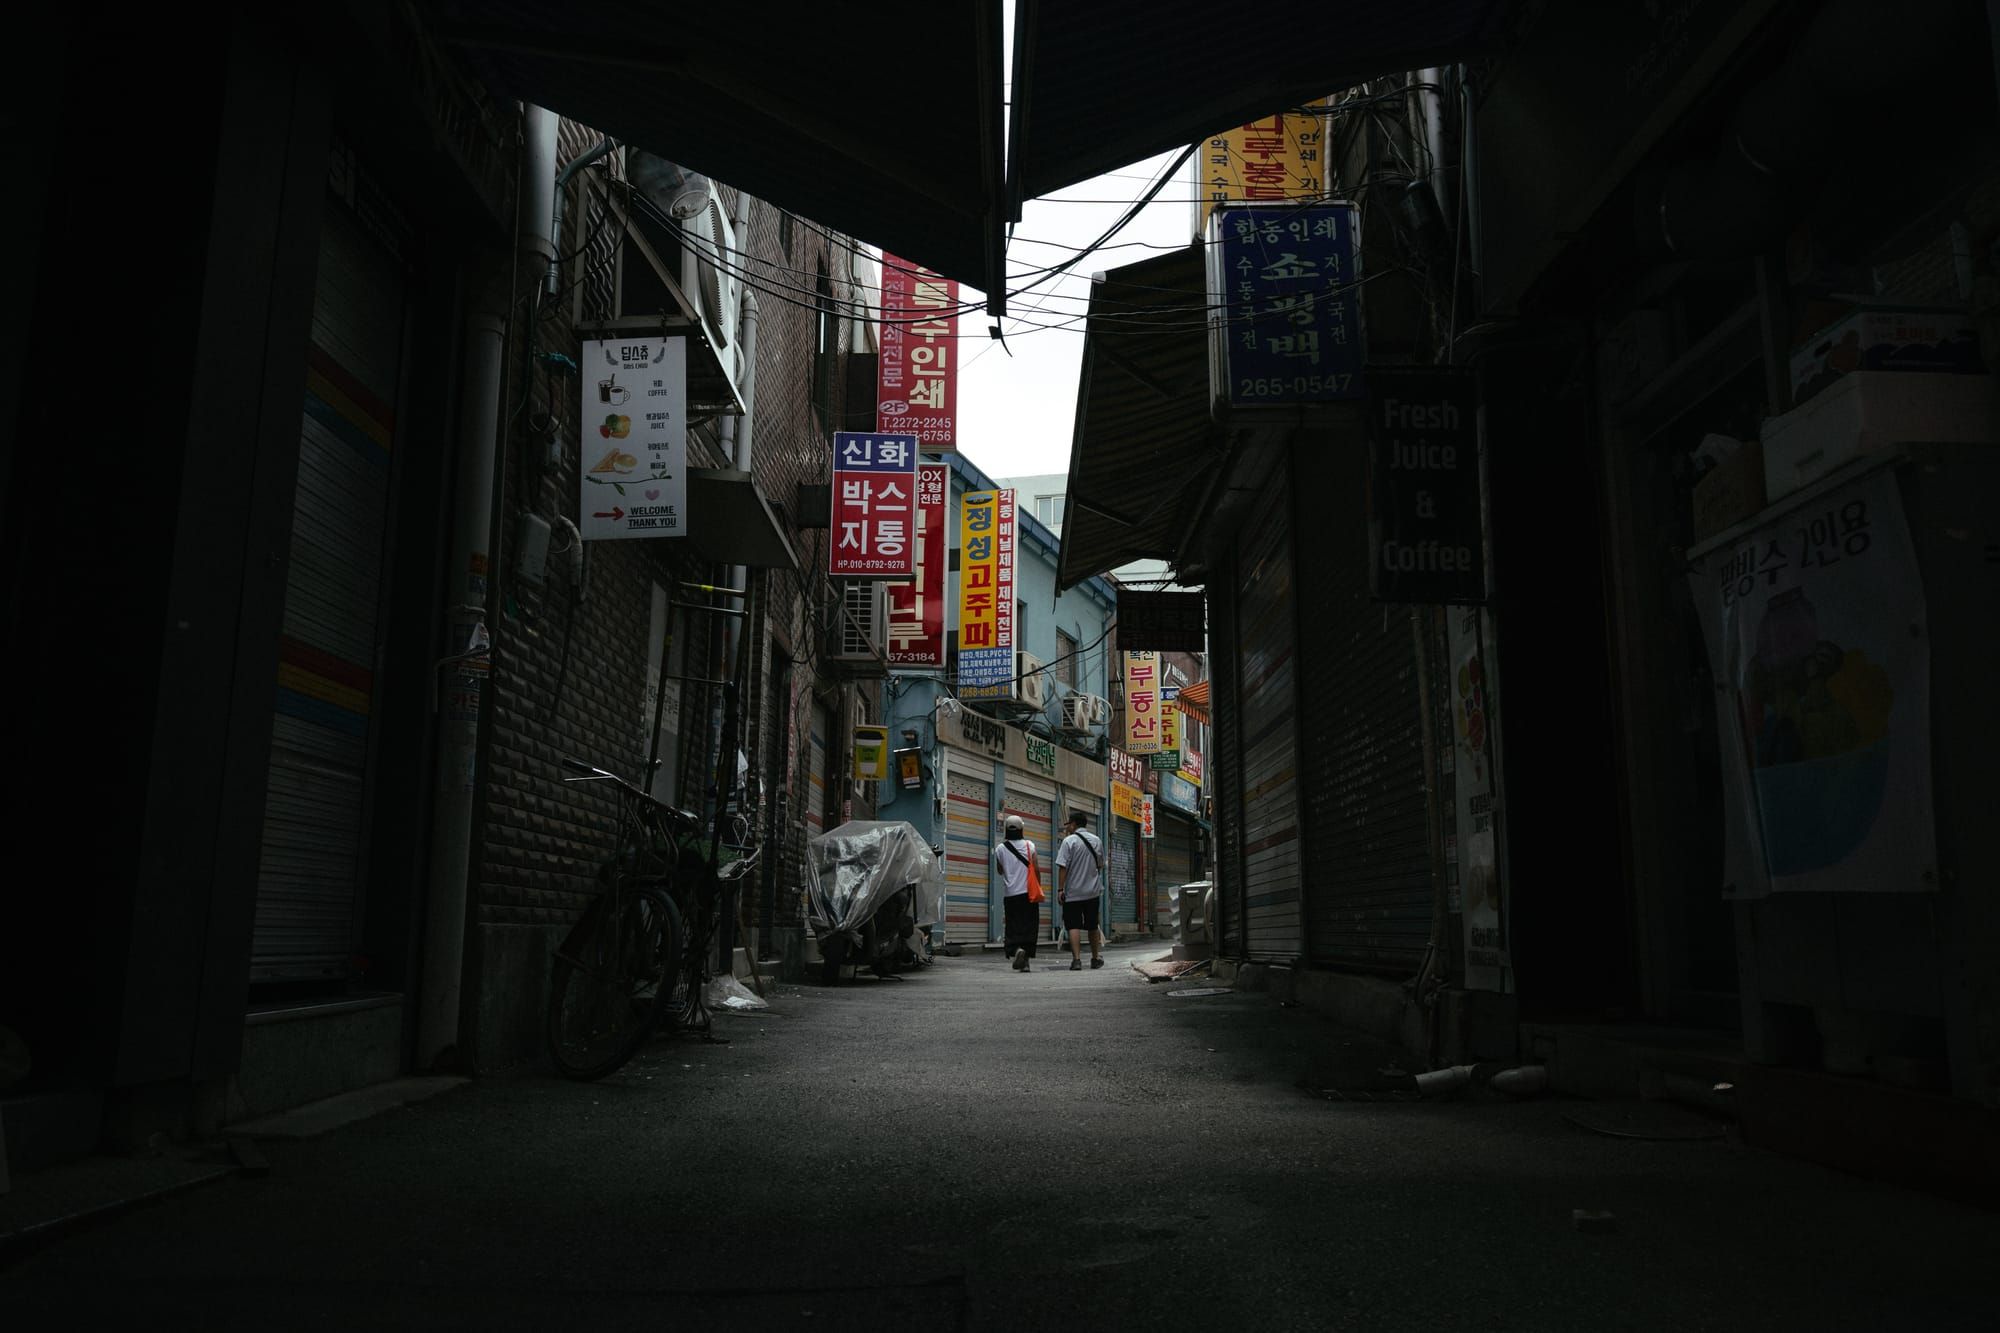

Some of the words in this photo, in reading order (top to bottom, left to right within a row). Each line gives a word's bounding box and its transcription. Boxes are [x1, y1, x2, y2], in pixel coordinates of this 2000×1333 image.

[1234, 216, 1337, 246] 합동인쇄
[1260, 252, 1321, 365] 쇼핑백
[621, 345, 649, 361] 딥스츄
[647, 389, 667, 397] COFFEE
[1240, 374, 1353, 398] 265-0547
[883, 402, 906, 413] 2F
[1383, 398, 1459, 430] Fresh
[650, 422, 665, 430] JUICE
[881, 416, 951, 429] T.2272-2245
[842, 439, 909, 468] 신화
[1389, 439, 1457, 471] Juice
[630, 506, 674, 515] WELCOME
[842, 479, 907, 515] 박스
[999, 489, 1013, 518] 각종
[1415, 489, 1437, 519] &
[628, 518, 657, 527] THANK
[659, 517, 677, 527] YOU
[1796, 499, 1872, 569] 2인용
[838, 519, 907, 556] 지통
[837, 559, 905, 569] HP.010-8792-9278
[1383, 540, 1473, 572] Coffee
[1130, 666, 1157, 740] 부동산
